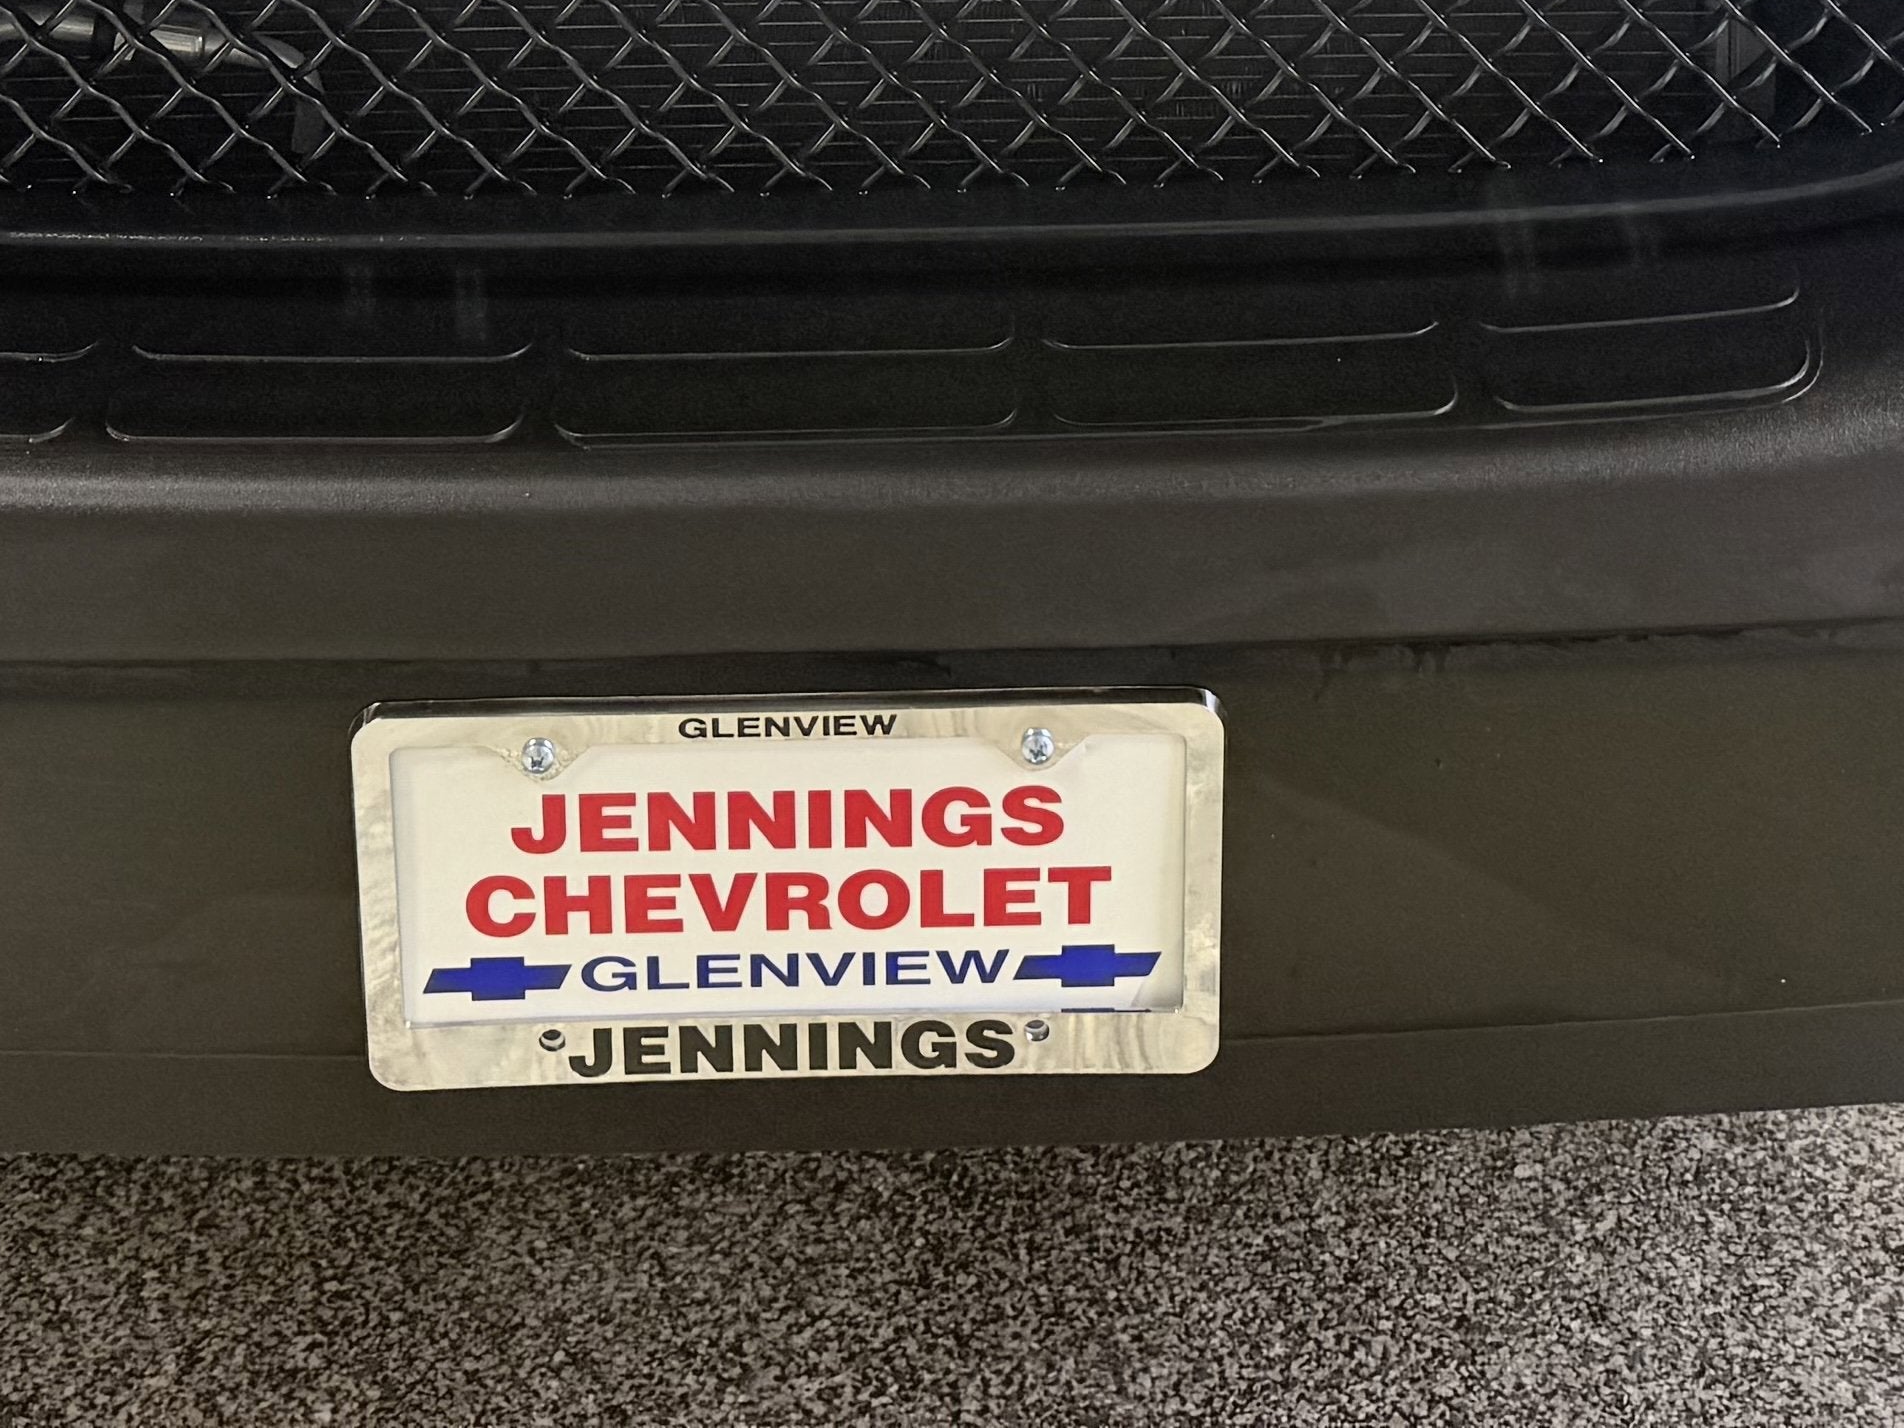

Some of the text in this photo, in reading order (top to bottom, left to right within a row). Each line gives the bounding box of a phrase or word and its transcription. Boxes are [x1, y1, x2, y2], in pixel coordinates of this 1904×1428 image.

[677, 713, 898, 739] GLENVIEW
[510, 785, 1065, 854] JENNINGS
[465, 866, 1112, 938] CHEVROLET
[580, 949, 1010, 992] GLENVIEW
[568, 1019, 1016, 1078] JENNINGS
